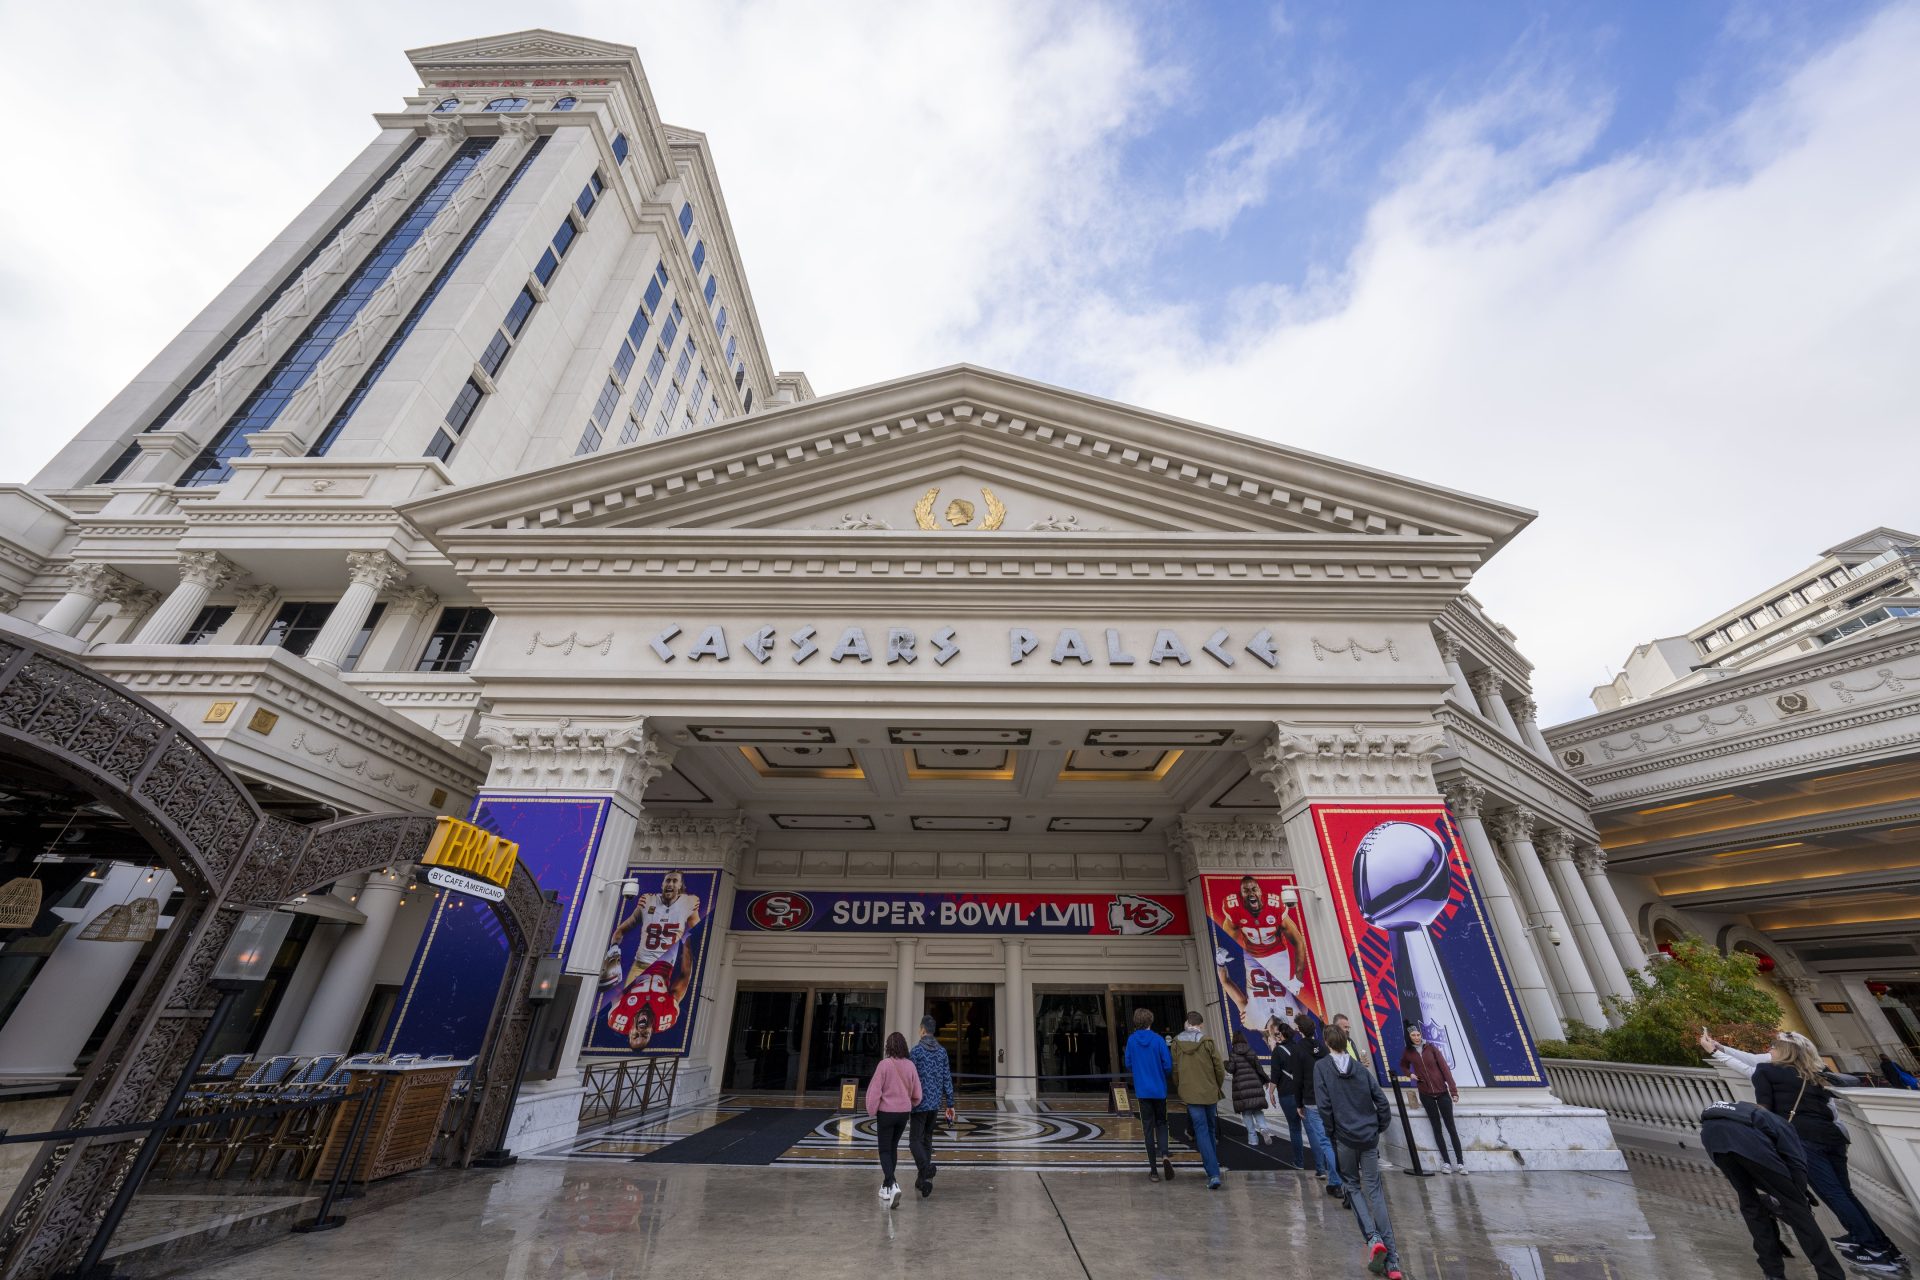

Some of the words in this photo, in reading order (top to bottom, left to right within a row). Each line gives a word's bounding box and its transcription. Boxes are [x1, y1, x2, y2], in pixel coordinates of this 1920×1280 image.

[649, 622, 961, 666] CAESARS
[1009, 626, 1279, 669] PALACE
[421, 815, 519, 889] TERRAZA
[444, 874, 464, 887] CAFE
[832, 901, 926, 926] SUPER
[940, 902, 1029, 926] BOWL
[1041, 902, 1095, 927] LVIII
[645, 922, 680, 951] 85
